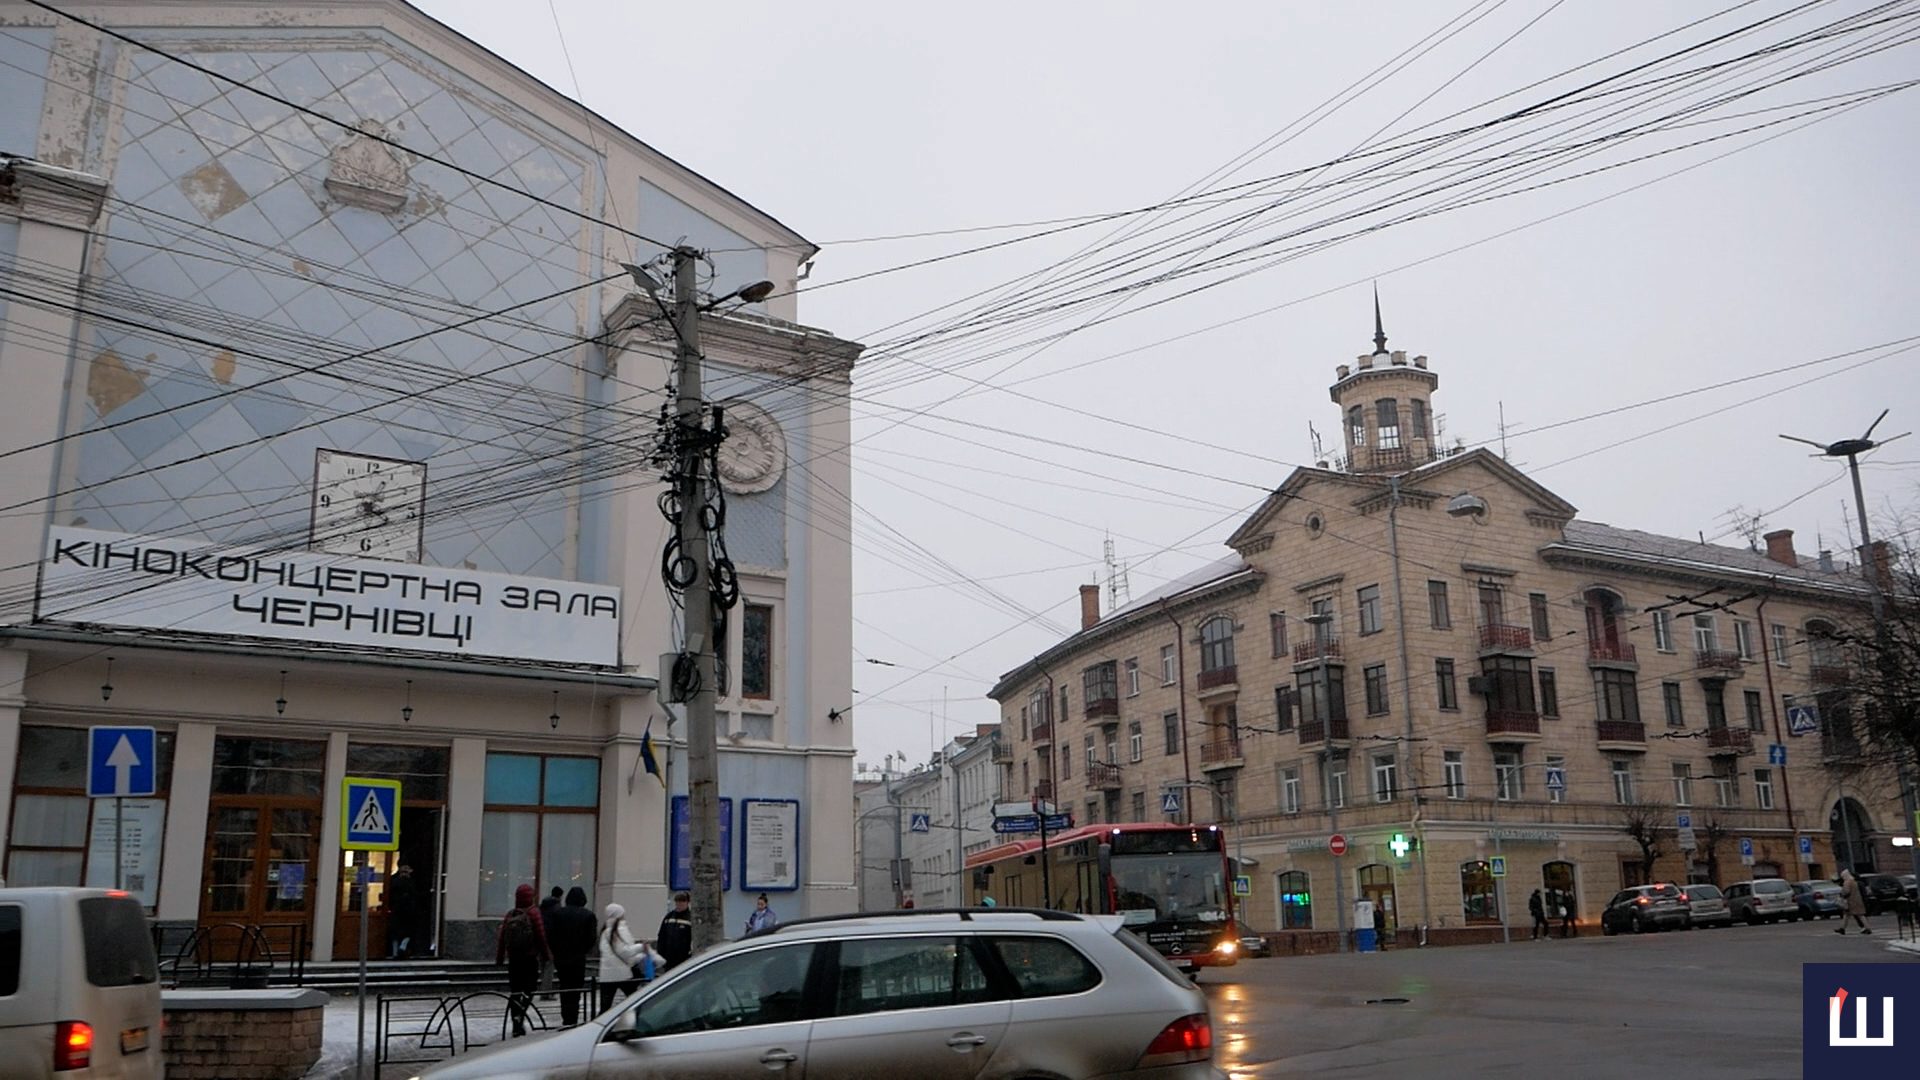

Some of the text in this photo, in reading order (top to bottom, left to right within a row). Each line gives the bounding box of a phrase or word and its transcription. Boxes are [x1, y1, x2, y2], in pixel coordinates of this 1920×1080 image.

[366, 461, 380, 474] 12
[320, 494, 331, 508] 9
[360, 538, 372, 552] 6
[53, 538, 617, 619] КІНОКОНЦЕРТНА ЗАЛА
[233, 593, 473, 648] ЧЕРНІВЦІ
